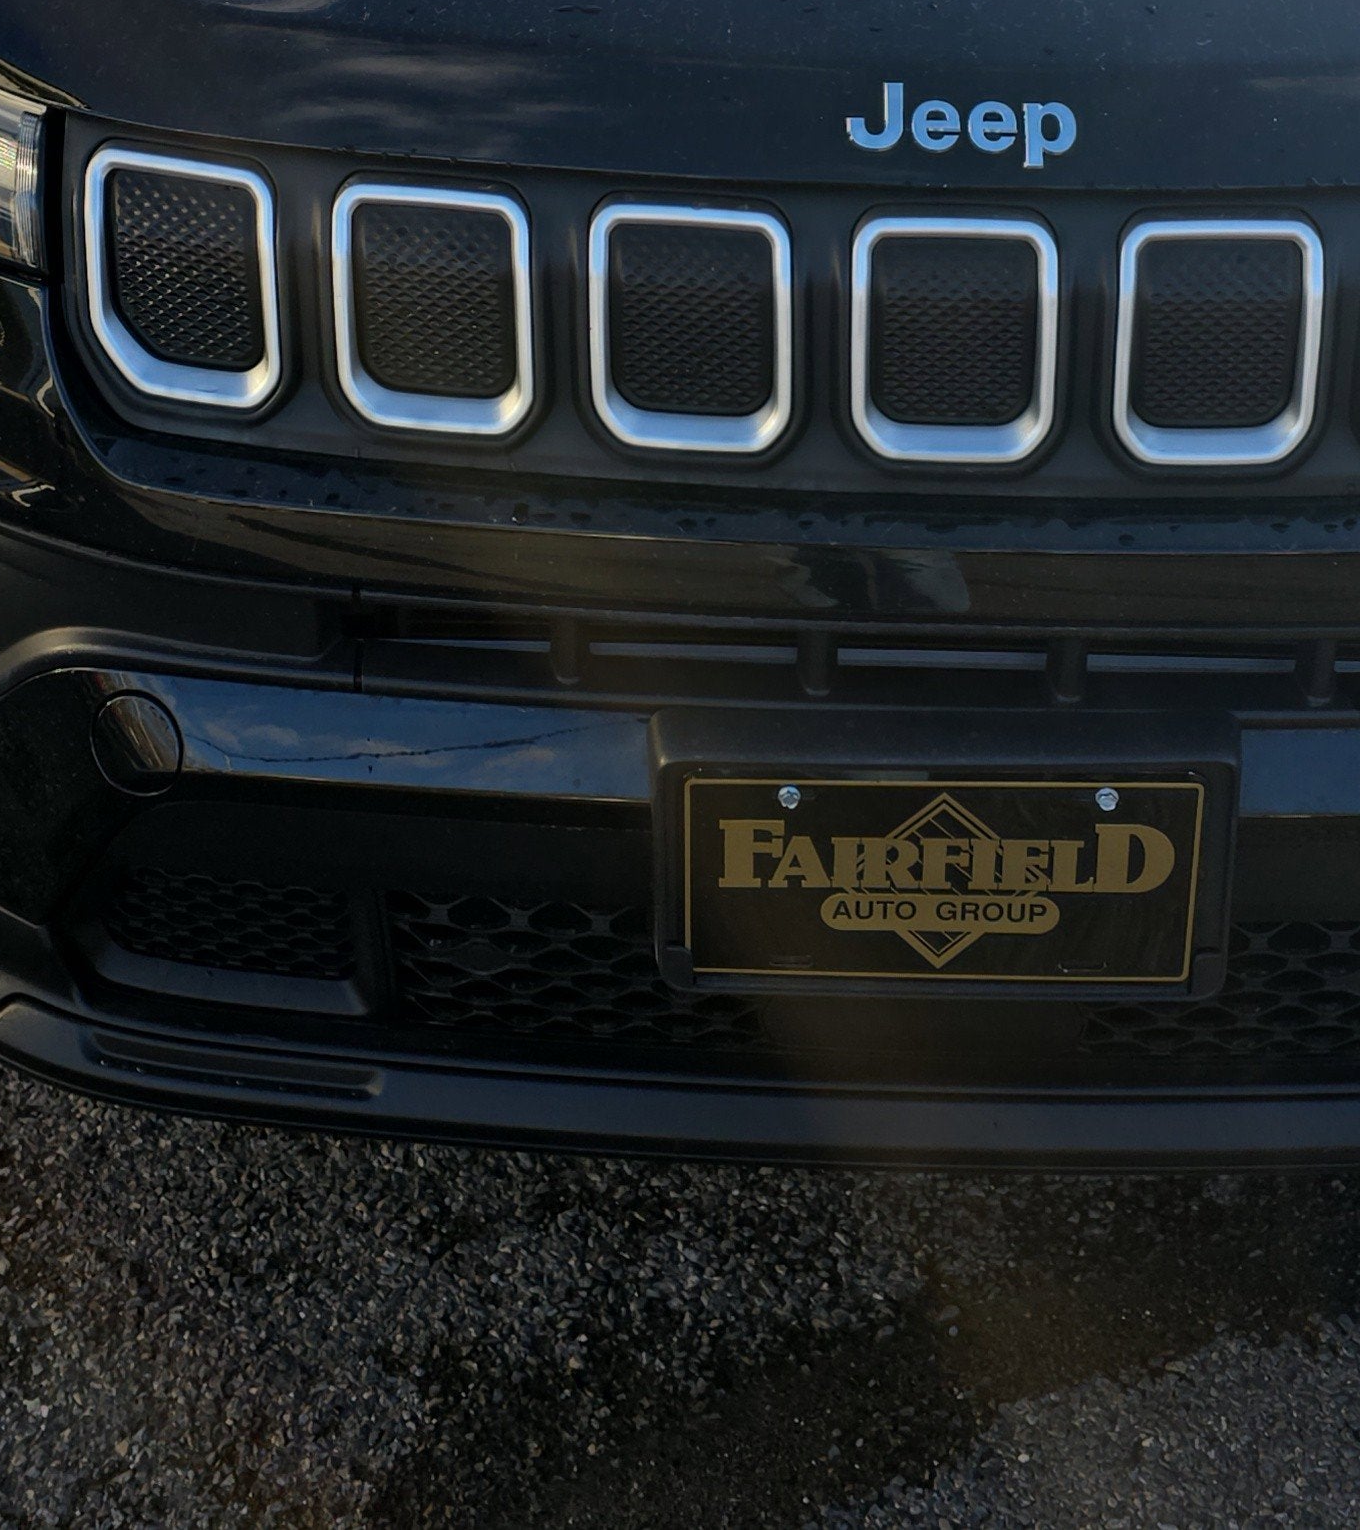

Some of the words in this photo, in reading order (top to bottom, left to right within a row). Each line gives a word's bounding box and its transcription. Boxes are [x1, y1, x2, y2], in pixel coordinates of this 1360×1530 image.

[845, 81, 1077, 169] Jeep
[718, 819, 1176, 893] FAIRFIELD
[831, 900, 917, 922] AUTO
[935, 901, 1048, 923] GROUP
